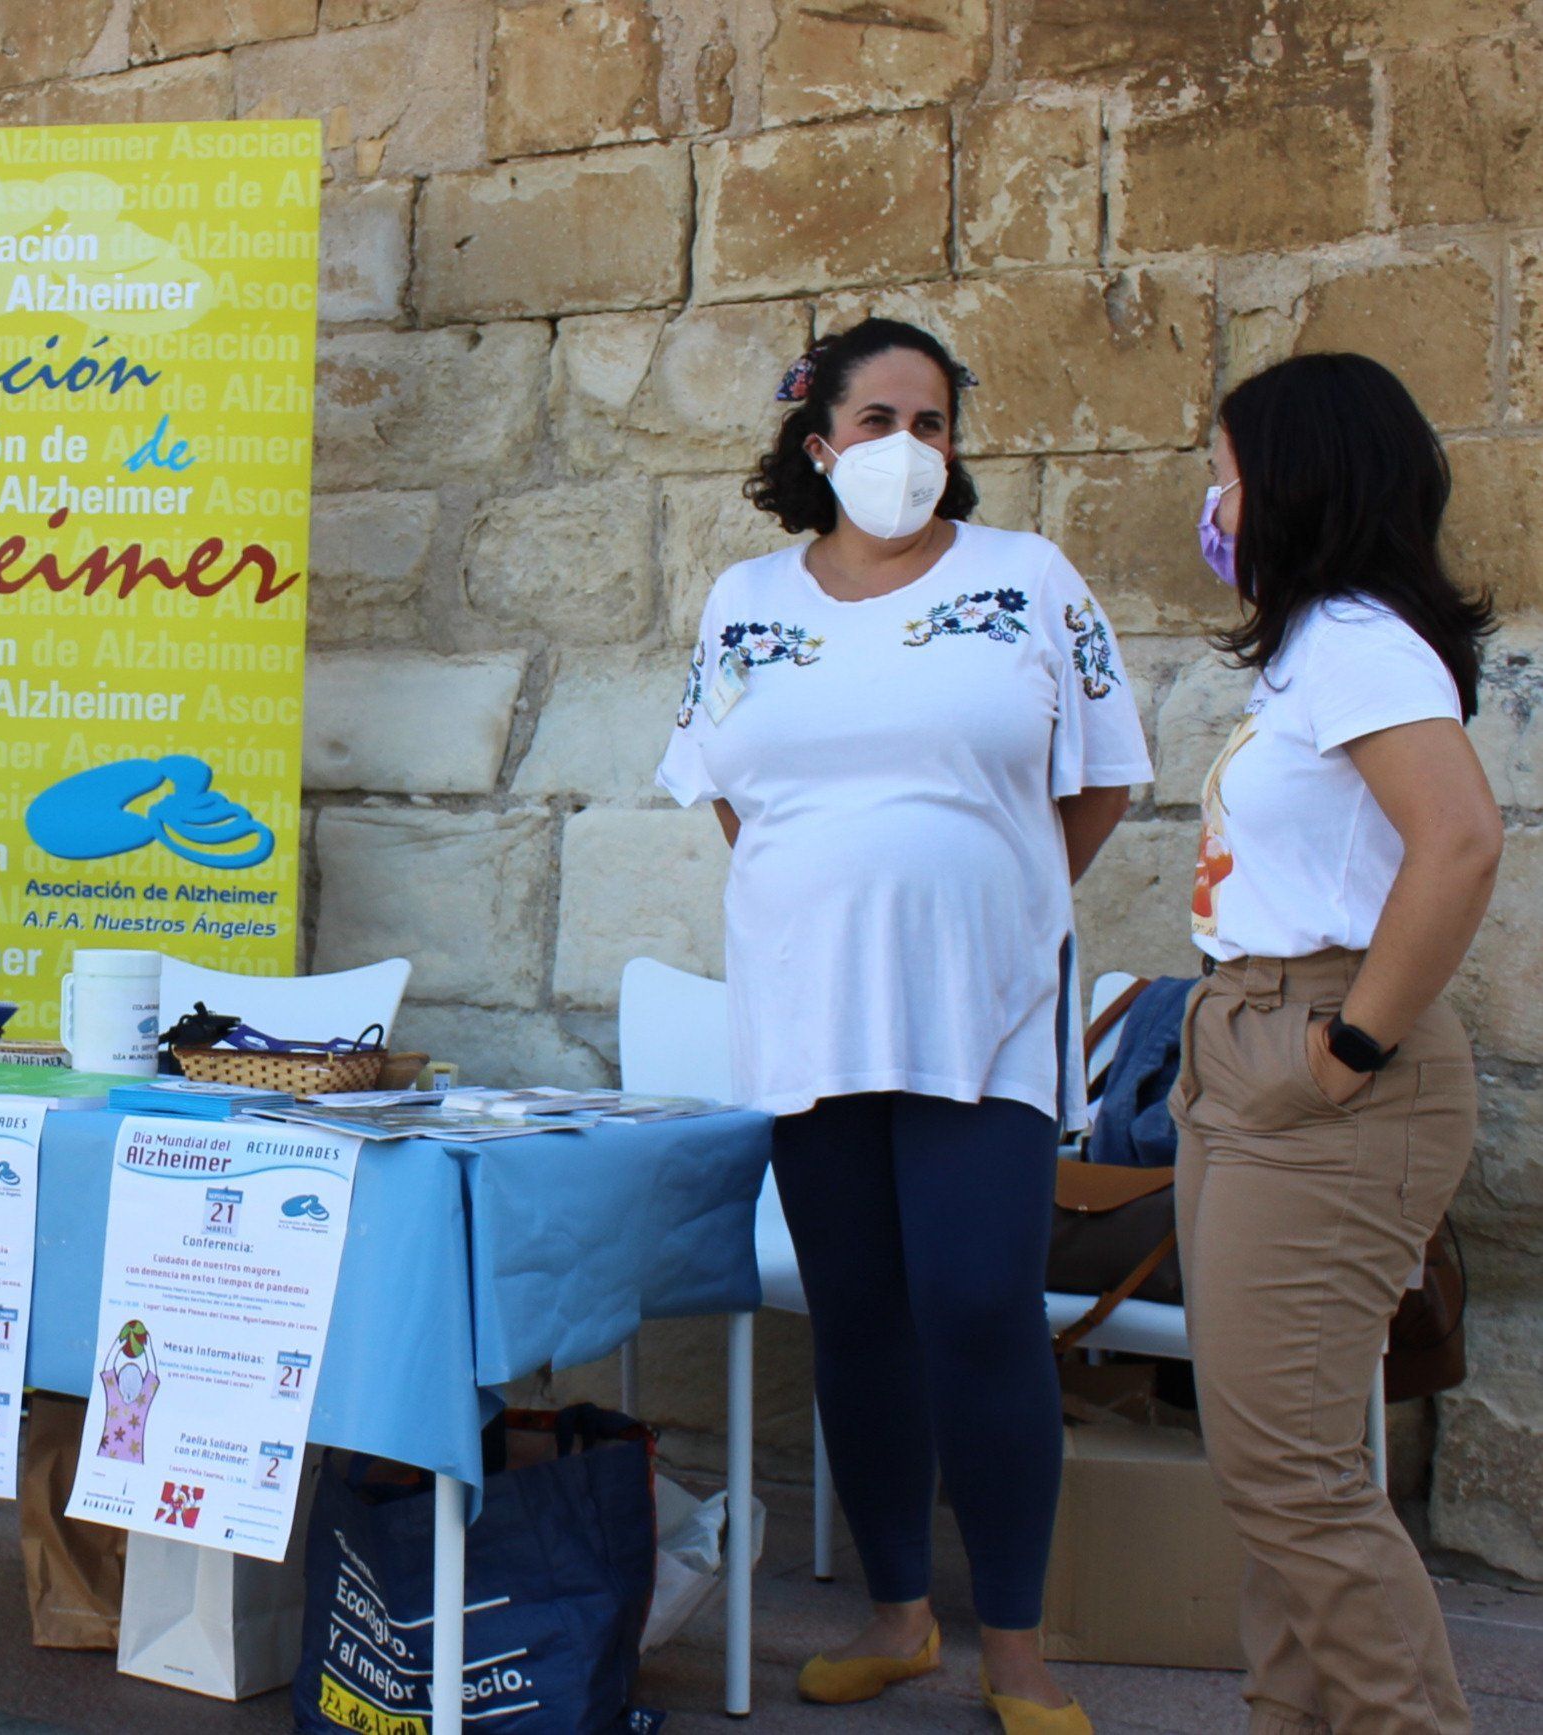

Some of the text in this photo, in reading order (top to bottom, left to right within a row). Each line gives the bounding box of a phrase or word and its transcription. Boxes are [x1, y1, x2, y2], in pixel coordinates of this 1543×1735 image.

[215, 171, 262, 208] de
[5, 273, 201, 312] Alzheimer
[160, 374, 206, 412] de
[40, 425, 87, 463] de
[120, 414, 196, 473] de
[31, 627, 79, 668] de
[93, 629, 298, 674] Alzheimer
[25, 878, 278, 906] Asociación de Alzheimer
[24, 911, 277, 940] A.F.A. Nuestros Ángeles
[126, 1145, 232, 1173] Alzheimer
[157, 1133, 207, 1150] Mundial
[210, 1138, 231, 1152] del
[246, 1141, 341, 1161] ACTIVIDADES
[210, 1201, 233, 1224] 21
[182, 1234, 254, 1253] Conferencia:
[152, 1253, 281, 1278] Cuidados de nuestros mayores
[125, 1265, 310, 1296] con demencia en estos tiempos de pandemia
[163, 1341, 266, 1366] Mesas Informativas:
[280, 1365, 302, 1389] 21
[174, 1445, 190, 1456] con
[180, 1431, 248, 1453] Paella Solidaria
[266, 1456, 280, 1479] 2
[328, 1622, 341, 1652] Y
[339, 1641, 358, 1669] al
[358, 1653, 416, 1702] mejor
